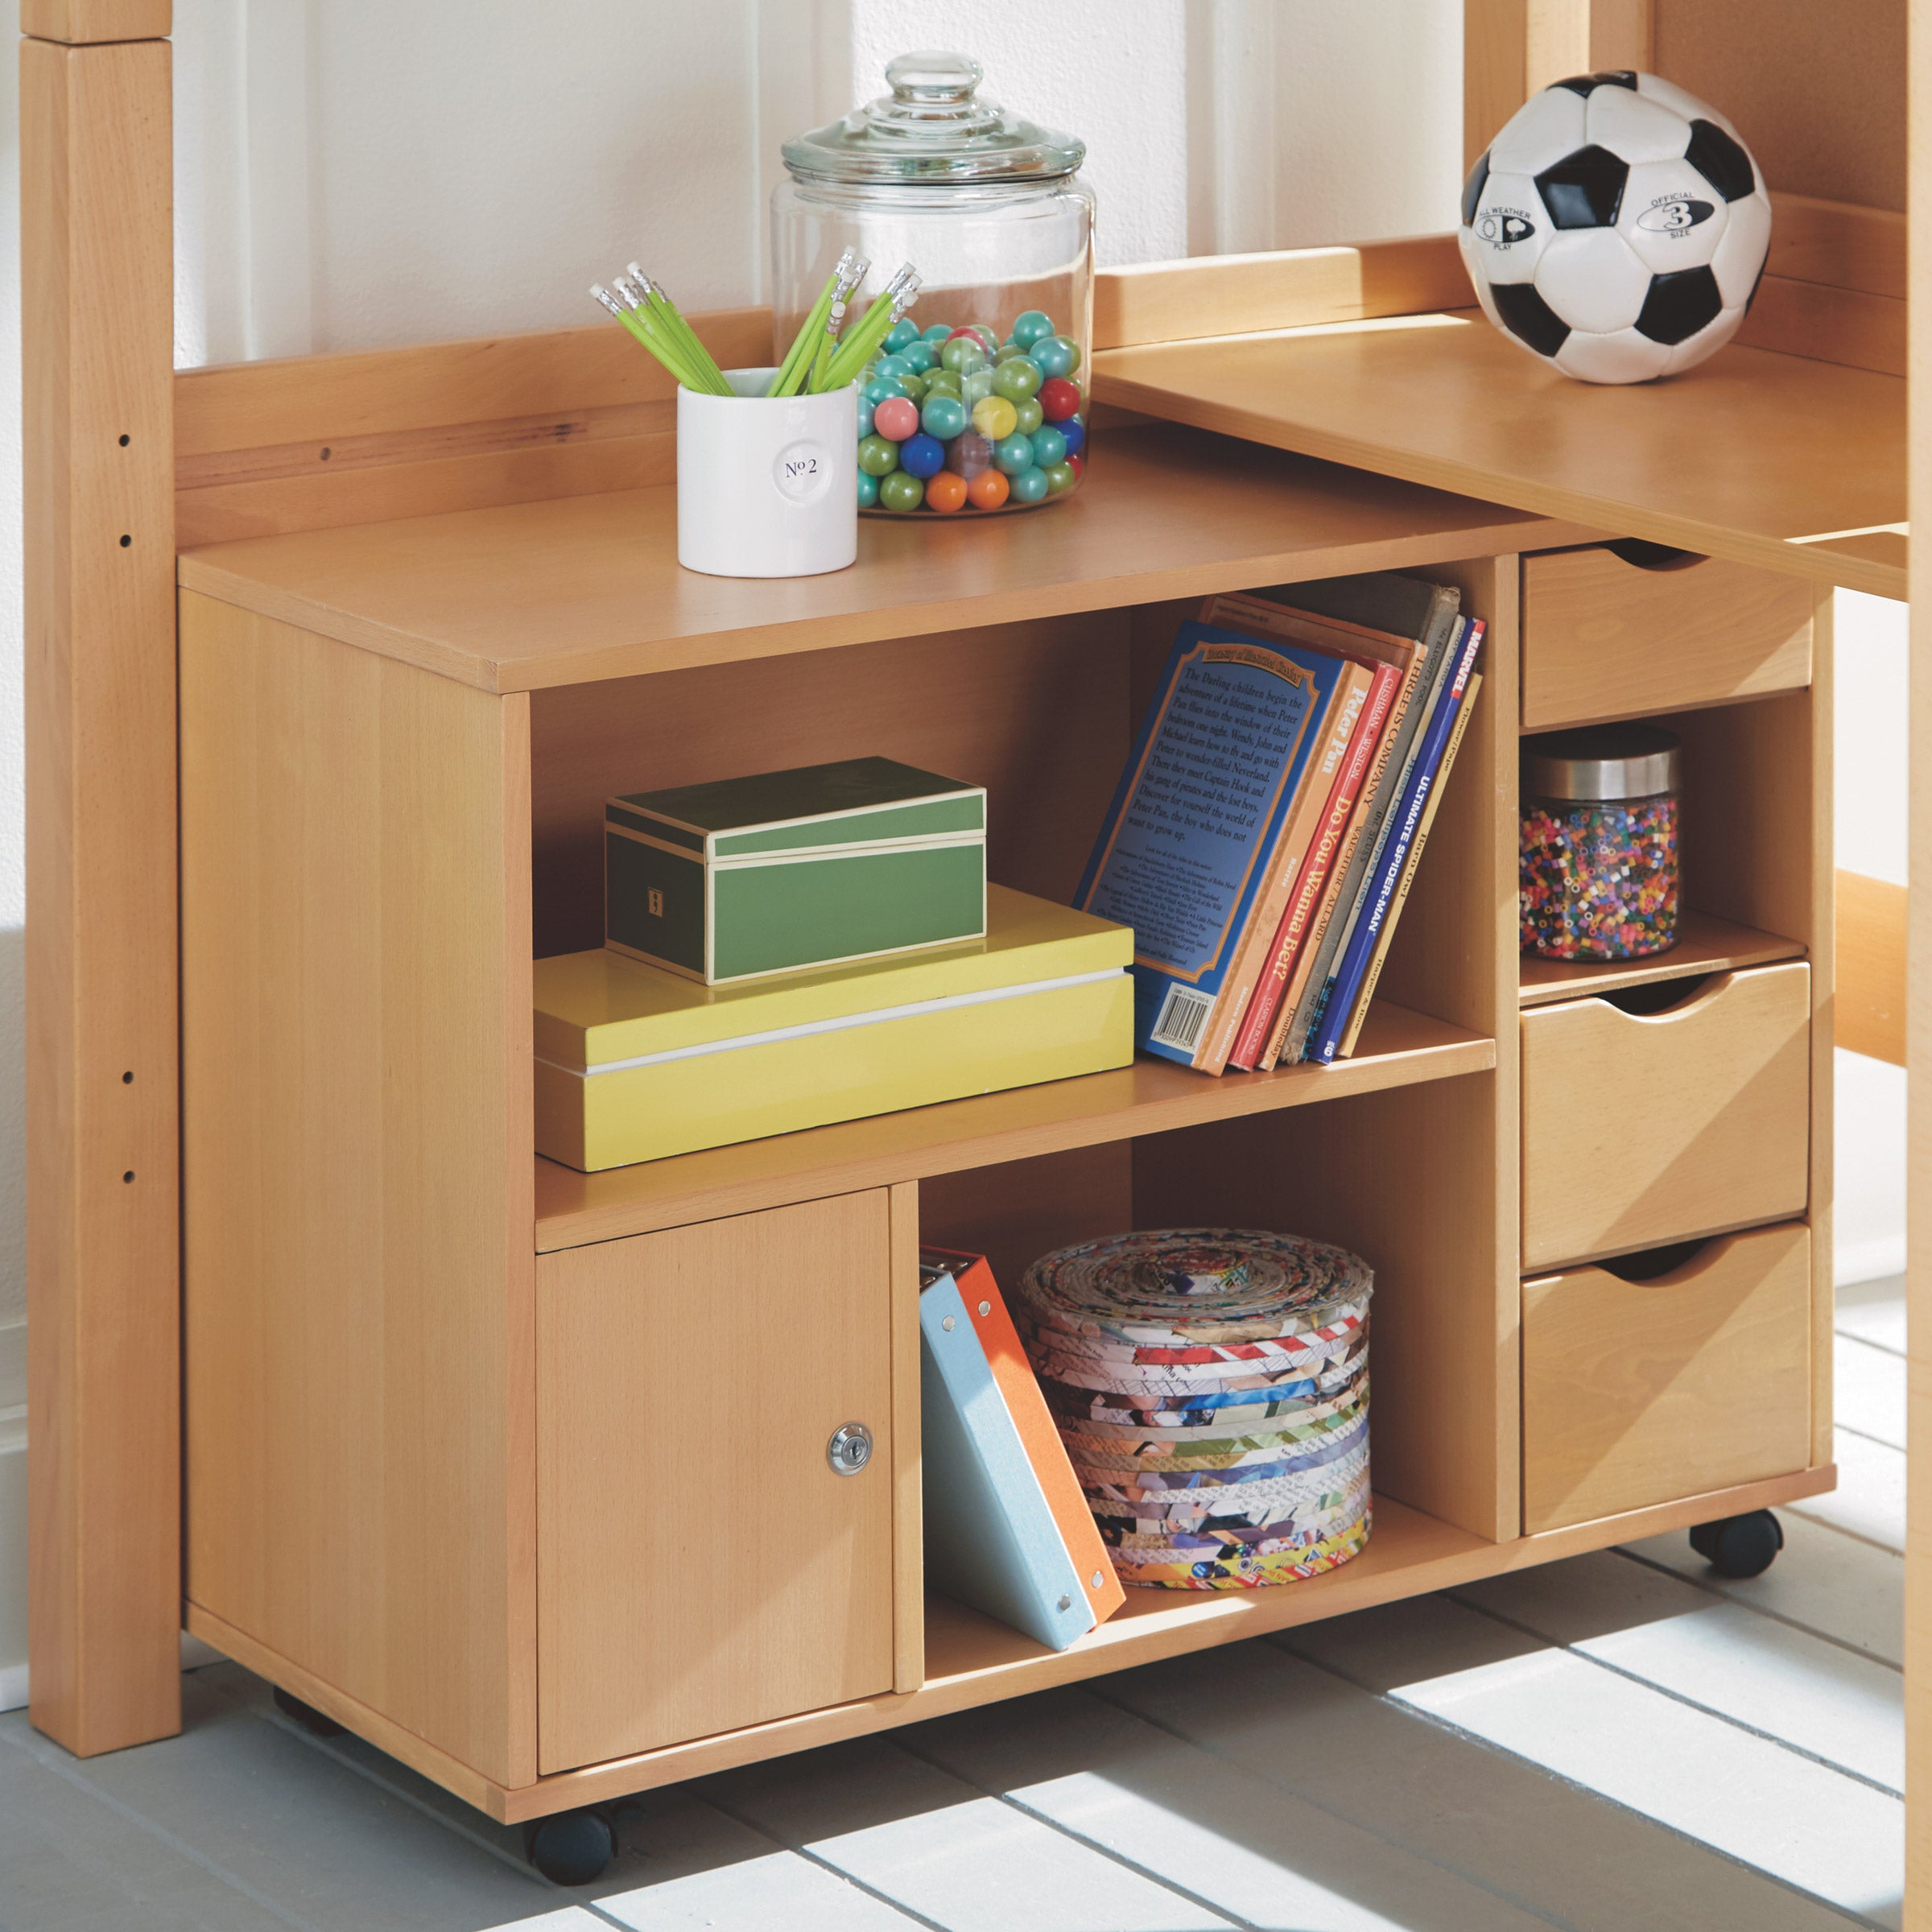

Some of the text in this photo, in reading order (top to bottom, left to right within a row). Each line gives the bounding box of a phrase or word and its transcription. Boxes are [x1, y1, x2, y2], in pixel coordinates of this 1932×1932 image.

[1492, 206, 1531, 219] WEATHER
[1651, 192, 1695, 206] OFFICIAL
[1662, 200, 1693, 230] 3
[1493, 242, 1512, 251] PLAY
[1670, 229, 1691, 239] SIZE
[807, 459, 817, 473] 2
[1439, 655, 1454, 688] VARGA
[1452, 631, 1480, 691] MARVEL
[1178, 683, 1212, 700] adventure
[1213, 692, 1224, 702] of
[1228, 696, 1255, 712] lifetime
[1257, 705, 1276, 717] when
[1278, 709, 1297, 724] Peter
[1185, 667, 1302, 708] The Darling children begin the
[1415, 685, 1427, 705] POOL
[1172, 696, 1187, 709] Pan
[1220, 710, 1232, 722] the
[1234, 716, 1260, 729] window
[1262, 723, 1273, 733] of
[1272, 724, 1290, 738] their
[1322, 686, 1367, 773] Peter Pan
[1350, 678, 1393, 778] CUSHMAN WESTON
[1364, 658, 1423, 808] THREE IS COMPANY
[1155, 740, 1174, 753] Peter
[1175, 748, 1183, 757] to
[1231, 762, 1269, 782] Neverland.
[1162, 725, 1188, 741] Michael
[1187, 733, 1205, 746] learn
[1205, 737, 1220, 750] how
[1221, 745, 1229, 753] to
[1240, 750, 1254, 761] and
[1253, 756, 1262, 764] go
[1264, 757, 1278, 768] with
[1253, 736, 1272, 749] John
[1272, 743, 1287, 753] and
[1170, 761, 1186, 774] they
[1203, 770, 1229, 786] Captain
[1230, 778, 1249, 792] Hook
[1250, 786, 1265, 797] and
[1171, 778, 1181, 788] of
[1179, 782, 1201, 795] pirates
[1202, 789, 1216, 799] and
[1216, 791, 1227, 803] the
[1228, 793, 1241, 807] lost
[1128, 816, 1145, 827] want
[1146, 821, 1154, 830] to
[1154, 825, 1171, 835] grow
[1133, 798, 1151, 812] Peter
[1170, 811, 1183, 822] the
[1183, 814, 1197, 828] boy
[1199, 819, 1214, 832] who
[1215, 824, 1231, 837] does
[1232, 832, 1246, 841] not
[1138, 783, 1256, 828] Discover for yourself the world of
[1335, 826, 1362, 886] WAECHTER
[1360, 830, 1375, 861] SEUSS
[1368, 776, 1429, 931] ULTIMATE SPIDER-MAN
[1400, 833, 1426, 898] Barn Owl
[1272, 795, 1350, 980] Do You Wanna Bet?
[1281, 857, 1296, 886] Barrie
[1315, 895, 1336, 942] ALLARD
[1367, 959, 1381, 994] Harper
[1214, 986, 1249, 1063] Modern Publishing
[1247, 997, 1272, 1054] CLARION BOOKS
[1270, 1007, 1295, 1059] Doubleday
[1355, 1009, 1364, 1029] Row
[1323, 1046, 1334, 1057] 6
